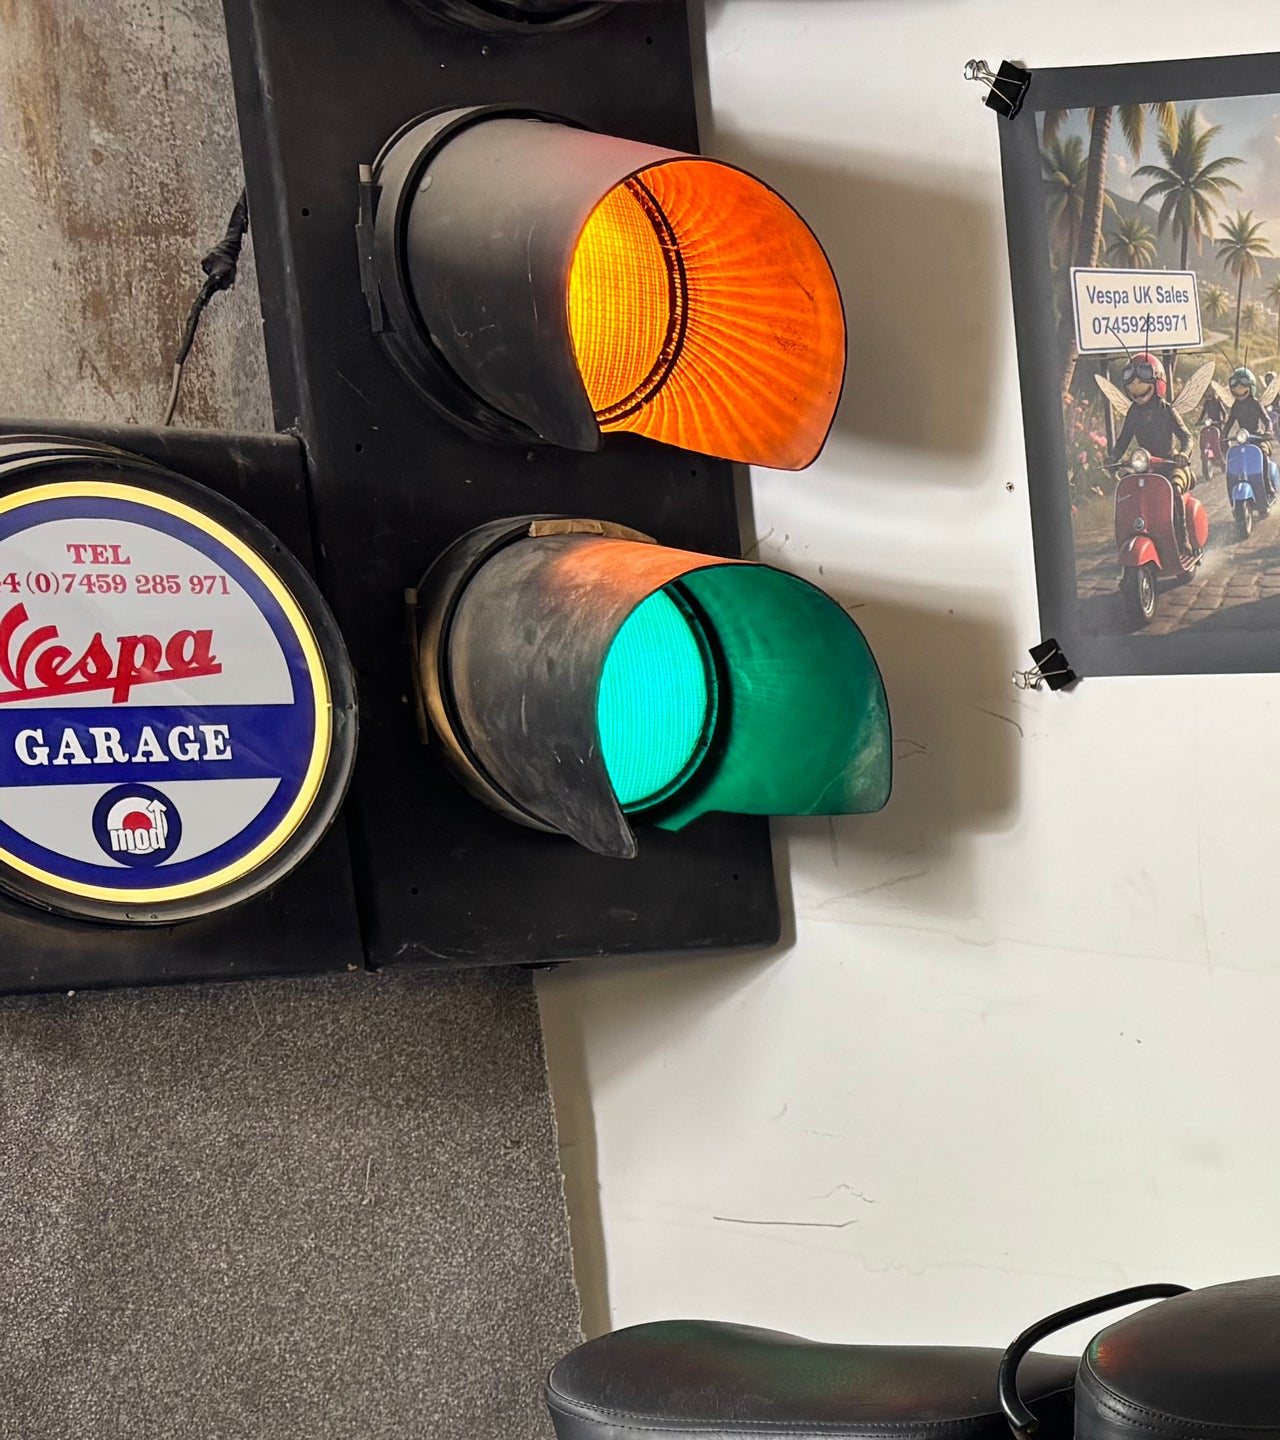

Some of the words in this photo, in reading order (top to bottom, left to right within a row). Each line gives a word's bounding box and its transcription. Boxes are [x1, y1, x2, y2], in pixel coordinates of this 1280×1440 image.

[1086, 285, 1130, 309] Vespa
[1133, 285, 1153, 305] UK
[1156, 285, 1189, 304] Sales
[1092, 314, 1188, 335] 07459285971
[66, 543, 131, 565] TEL
[135, 574, 182, 594] 285
[189, 575, 231, 595] 971
[0, 602, 222, 704] Vespa
[14, 724, 233, 766] GARAGE
